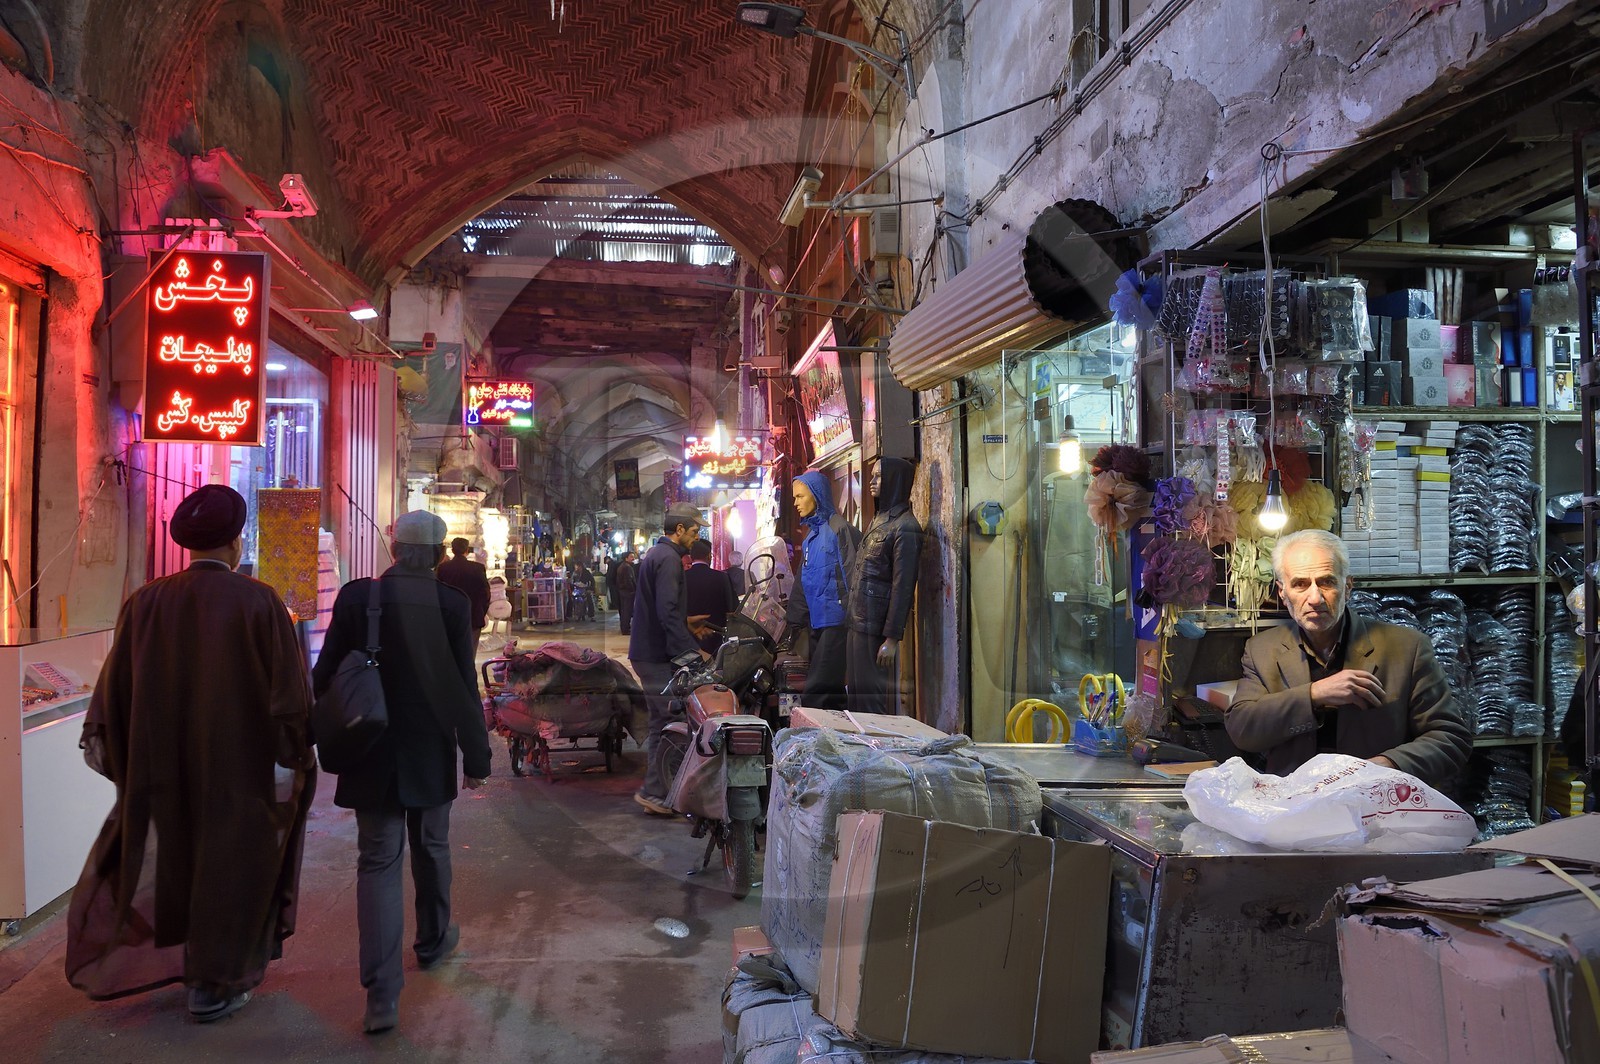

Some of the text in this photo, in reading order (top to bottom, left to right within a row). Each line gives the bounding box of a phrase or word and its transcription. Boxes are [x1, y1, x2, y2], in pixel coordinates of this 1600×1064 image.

[154, 258, 253, 326] پخش
[159, 336, 252, 375] بدلیجات
[476, 382, 494, 399] جهان
[493, 383, 508, 399] نقش
[158, 391, 192, 431] کش
[700, 458, 746, 475] لباس زیر
